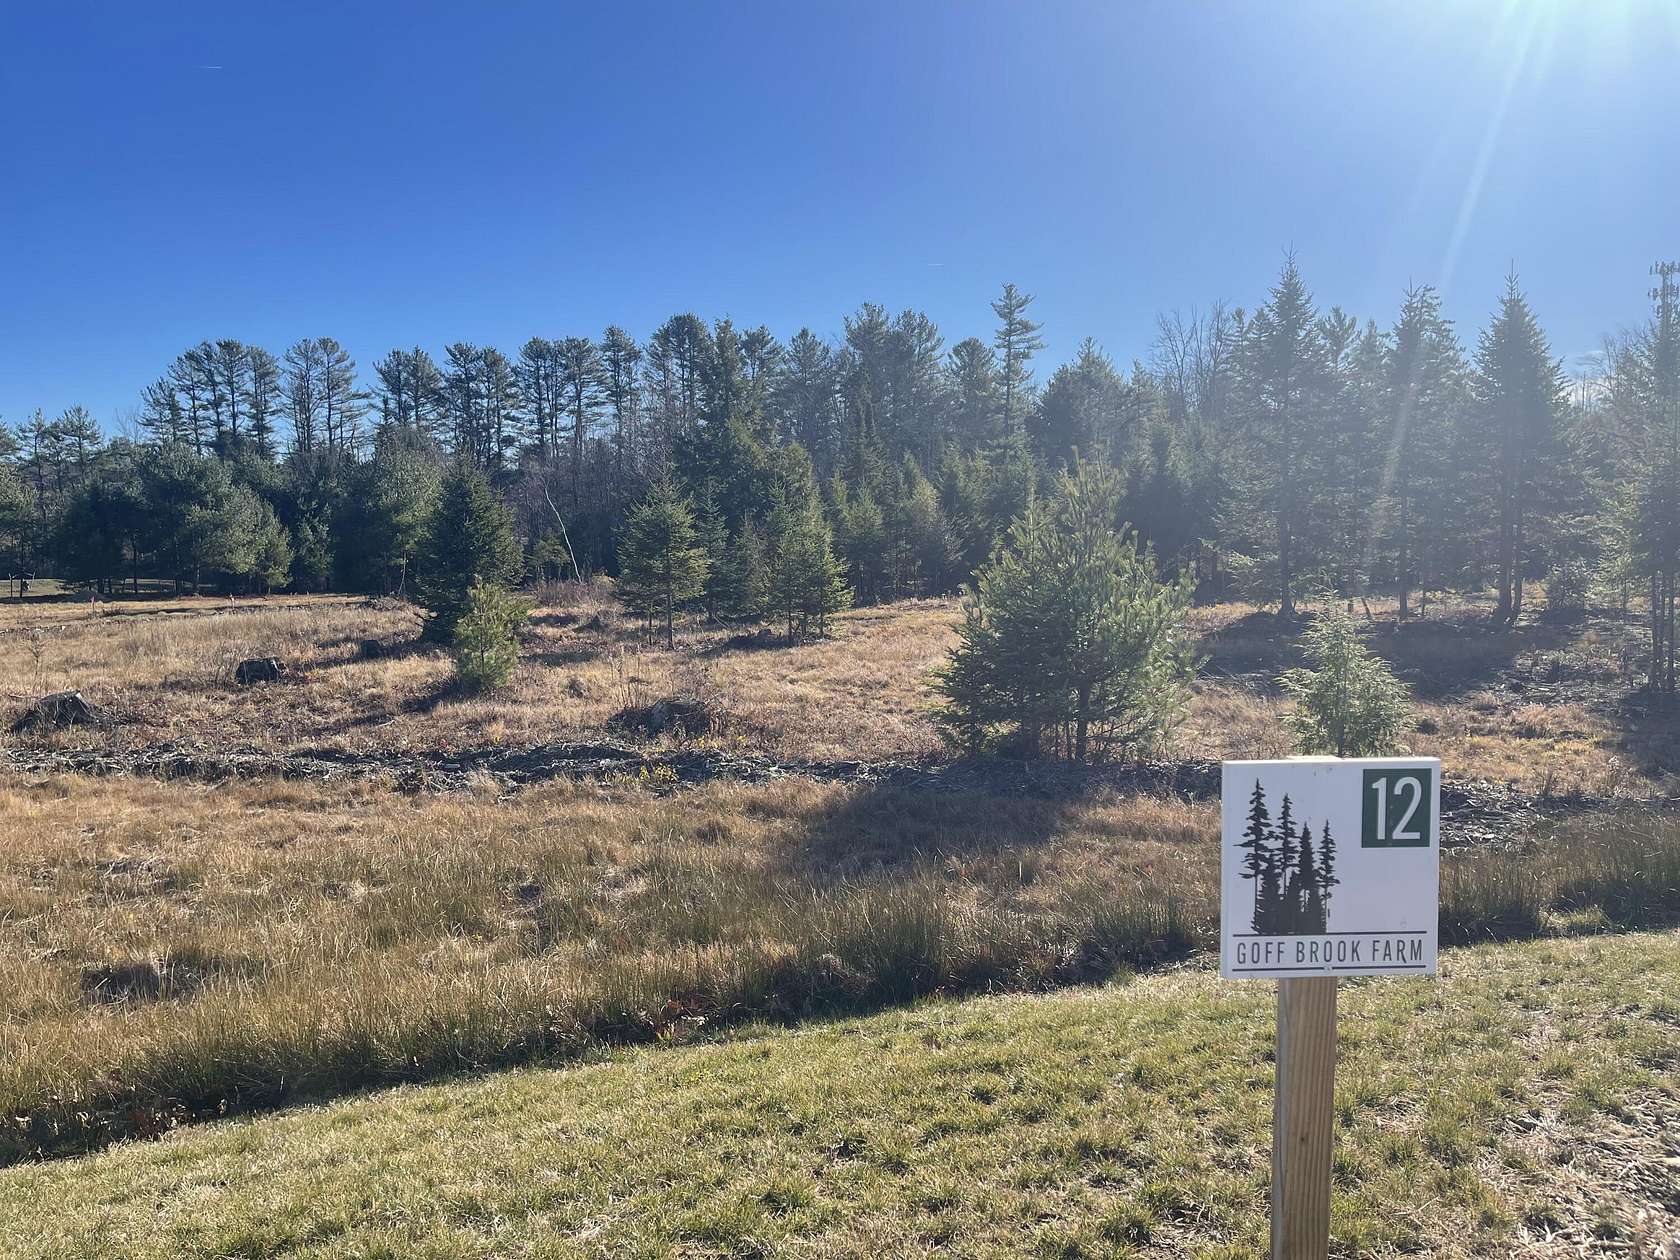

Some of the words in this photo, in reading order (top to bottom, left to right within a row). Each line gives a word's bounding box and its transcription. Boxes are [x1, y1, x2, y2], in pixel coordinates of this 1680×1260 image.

[1371, 776, 1422, 840] 12
[1237, 941, 1286, 964] GOFF
[1296, 940, 1361, 963] BROOK
[1372, 939, 1423, 963] FARM
